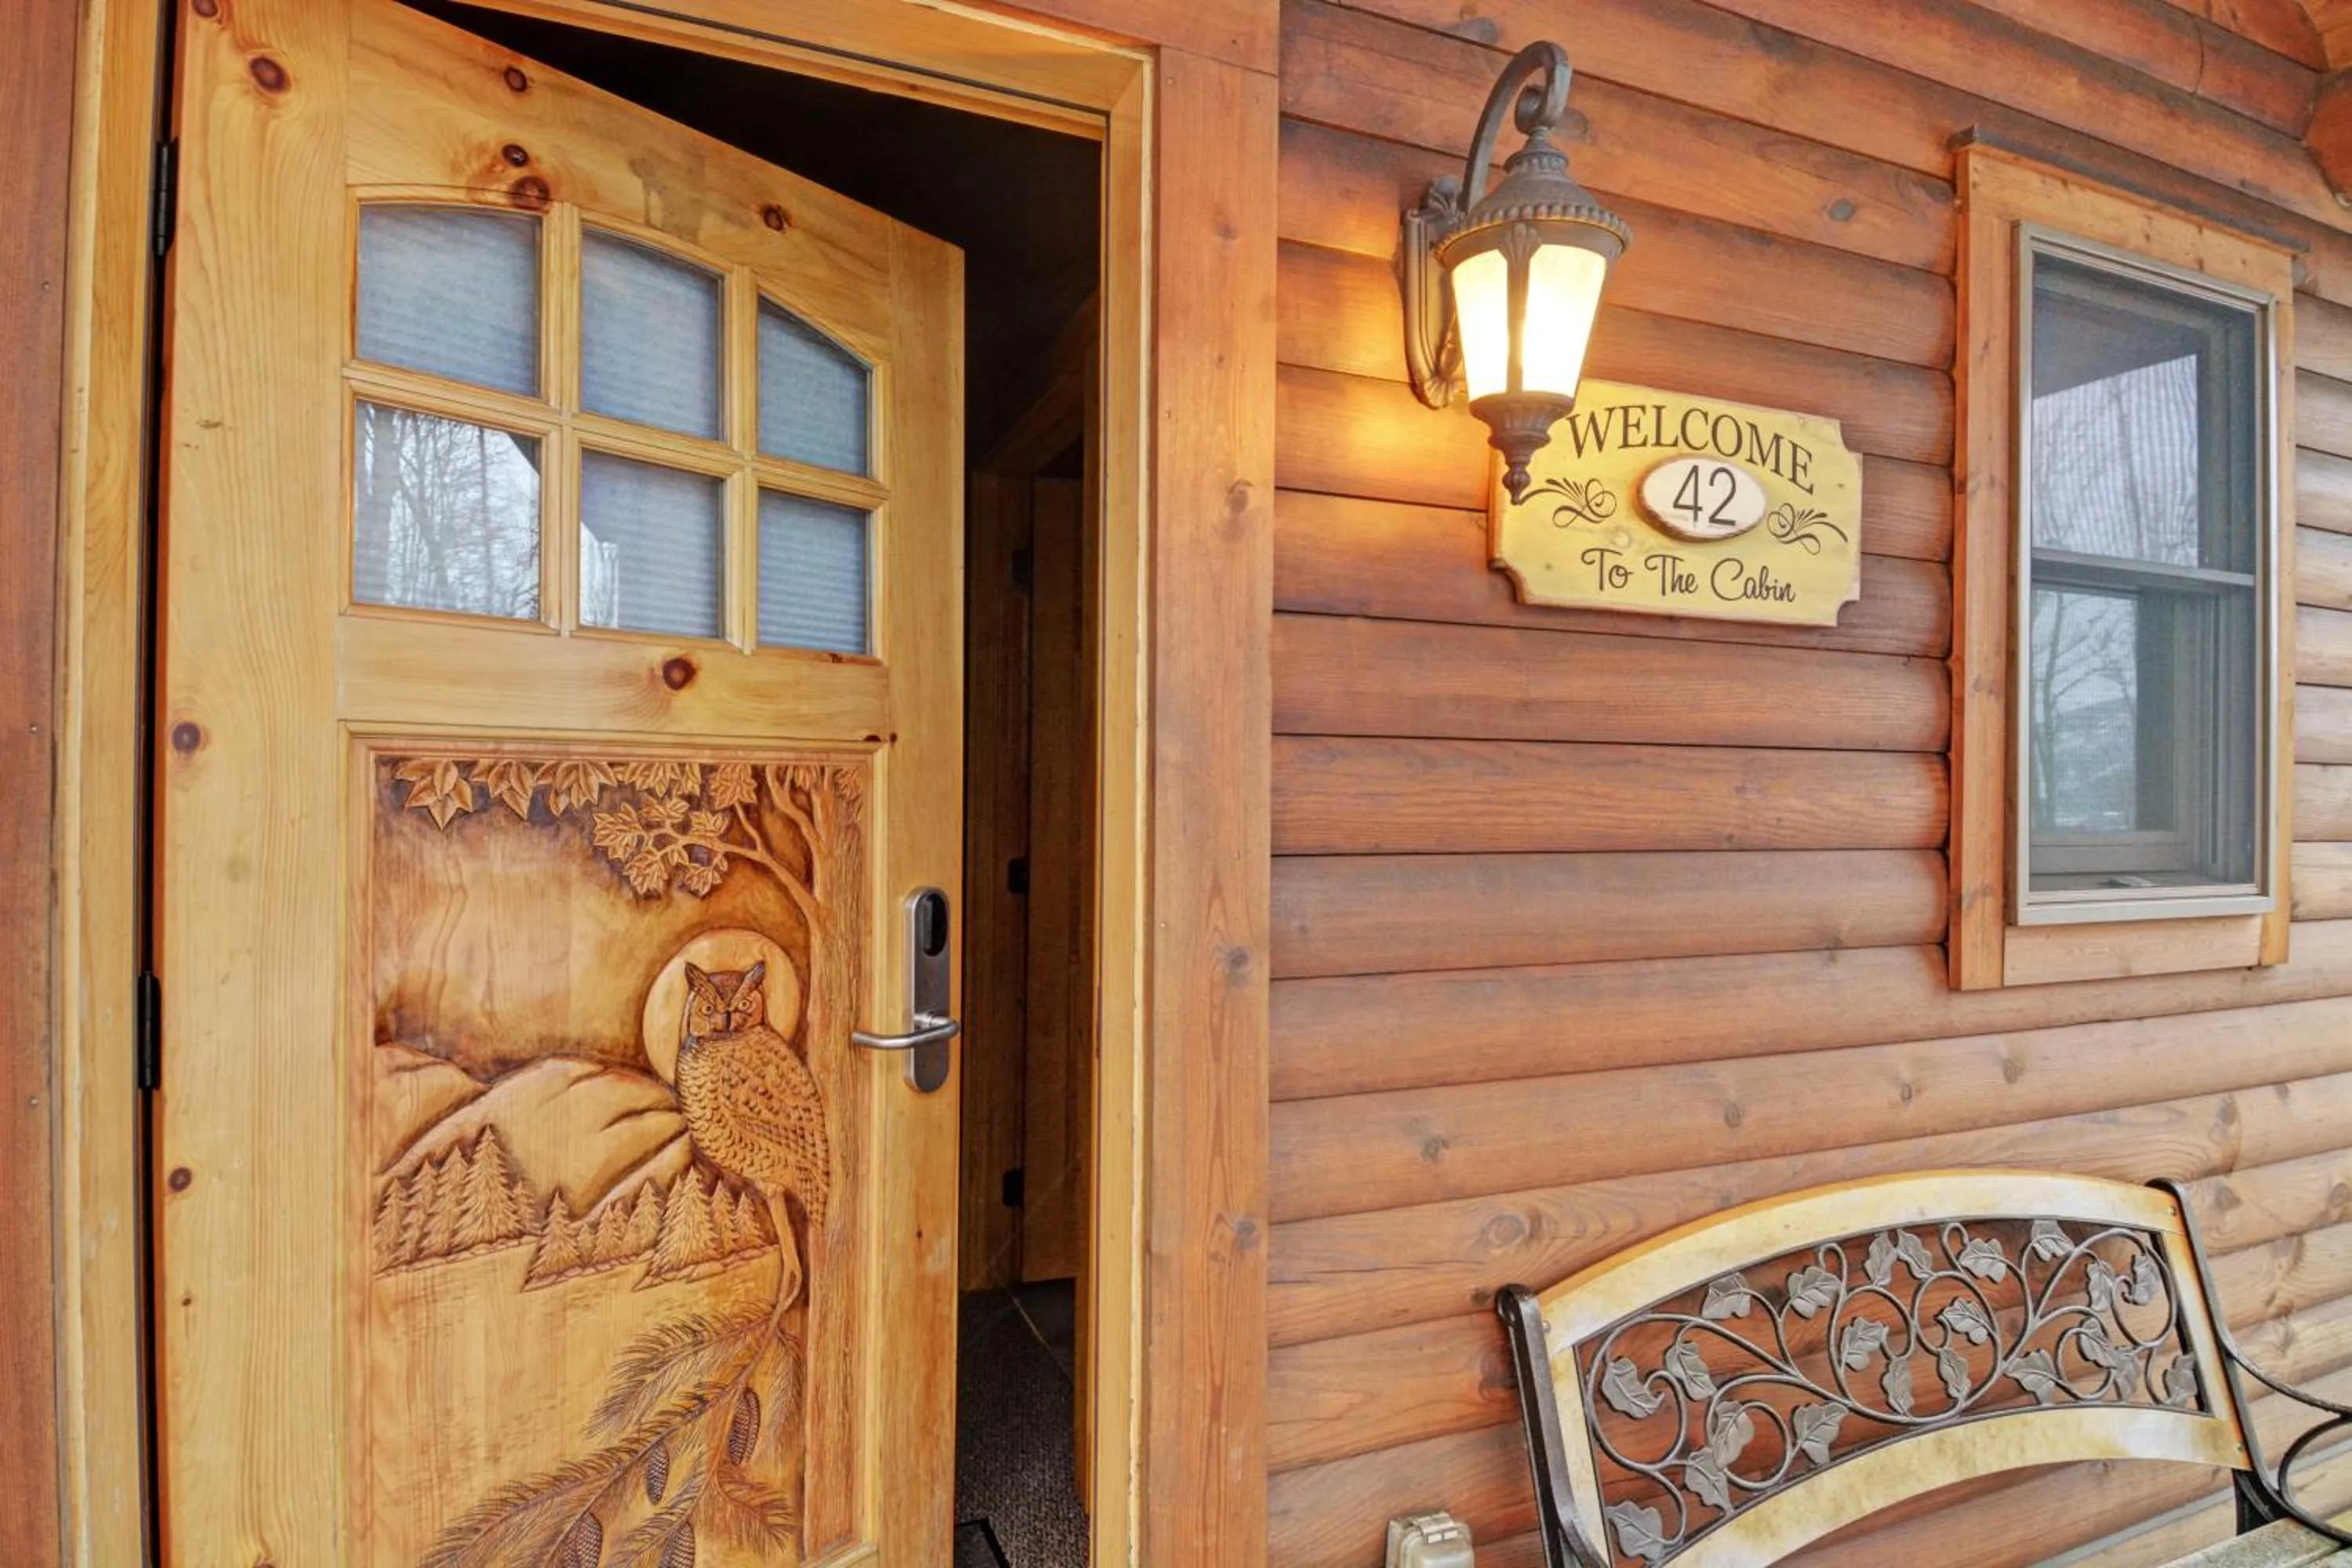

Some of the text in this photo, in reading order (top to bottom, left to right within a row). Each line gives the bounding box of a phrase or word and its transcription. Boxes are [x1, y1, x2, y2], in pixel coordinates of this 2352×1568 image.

[1566, 405, 1814, 495] WELCOME
[1672, 464, 1738, 527] 42
[1581, 548, 1795, 603] To The Cabin
